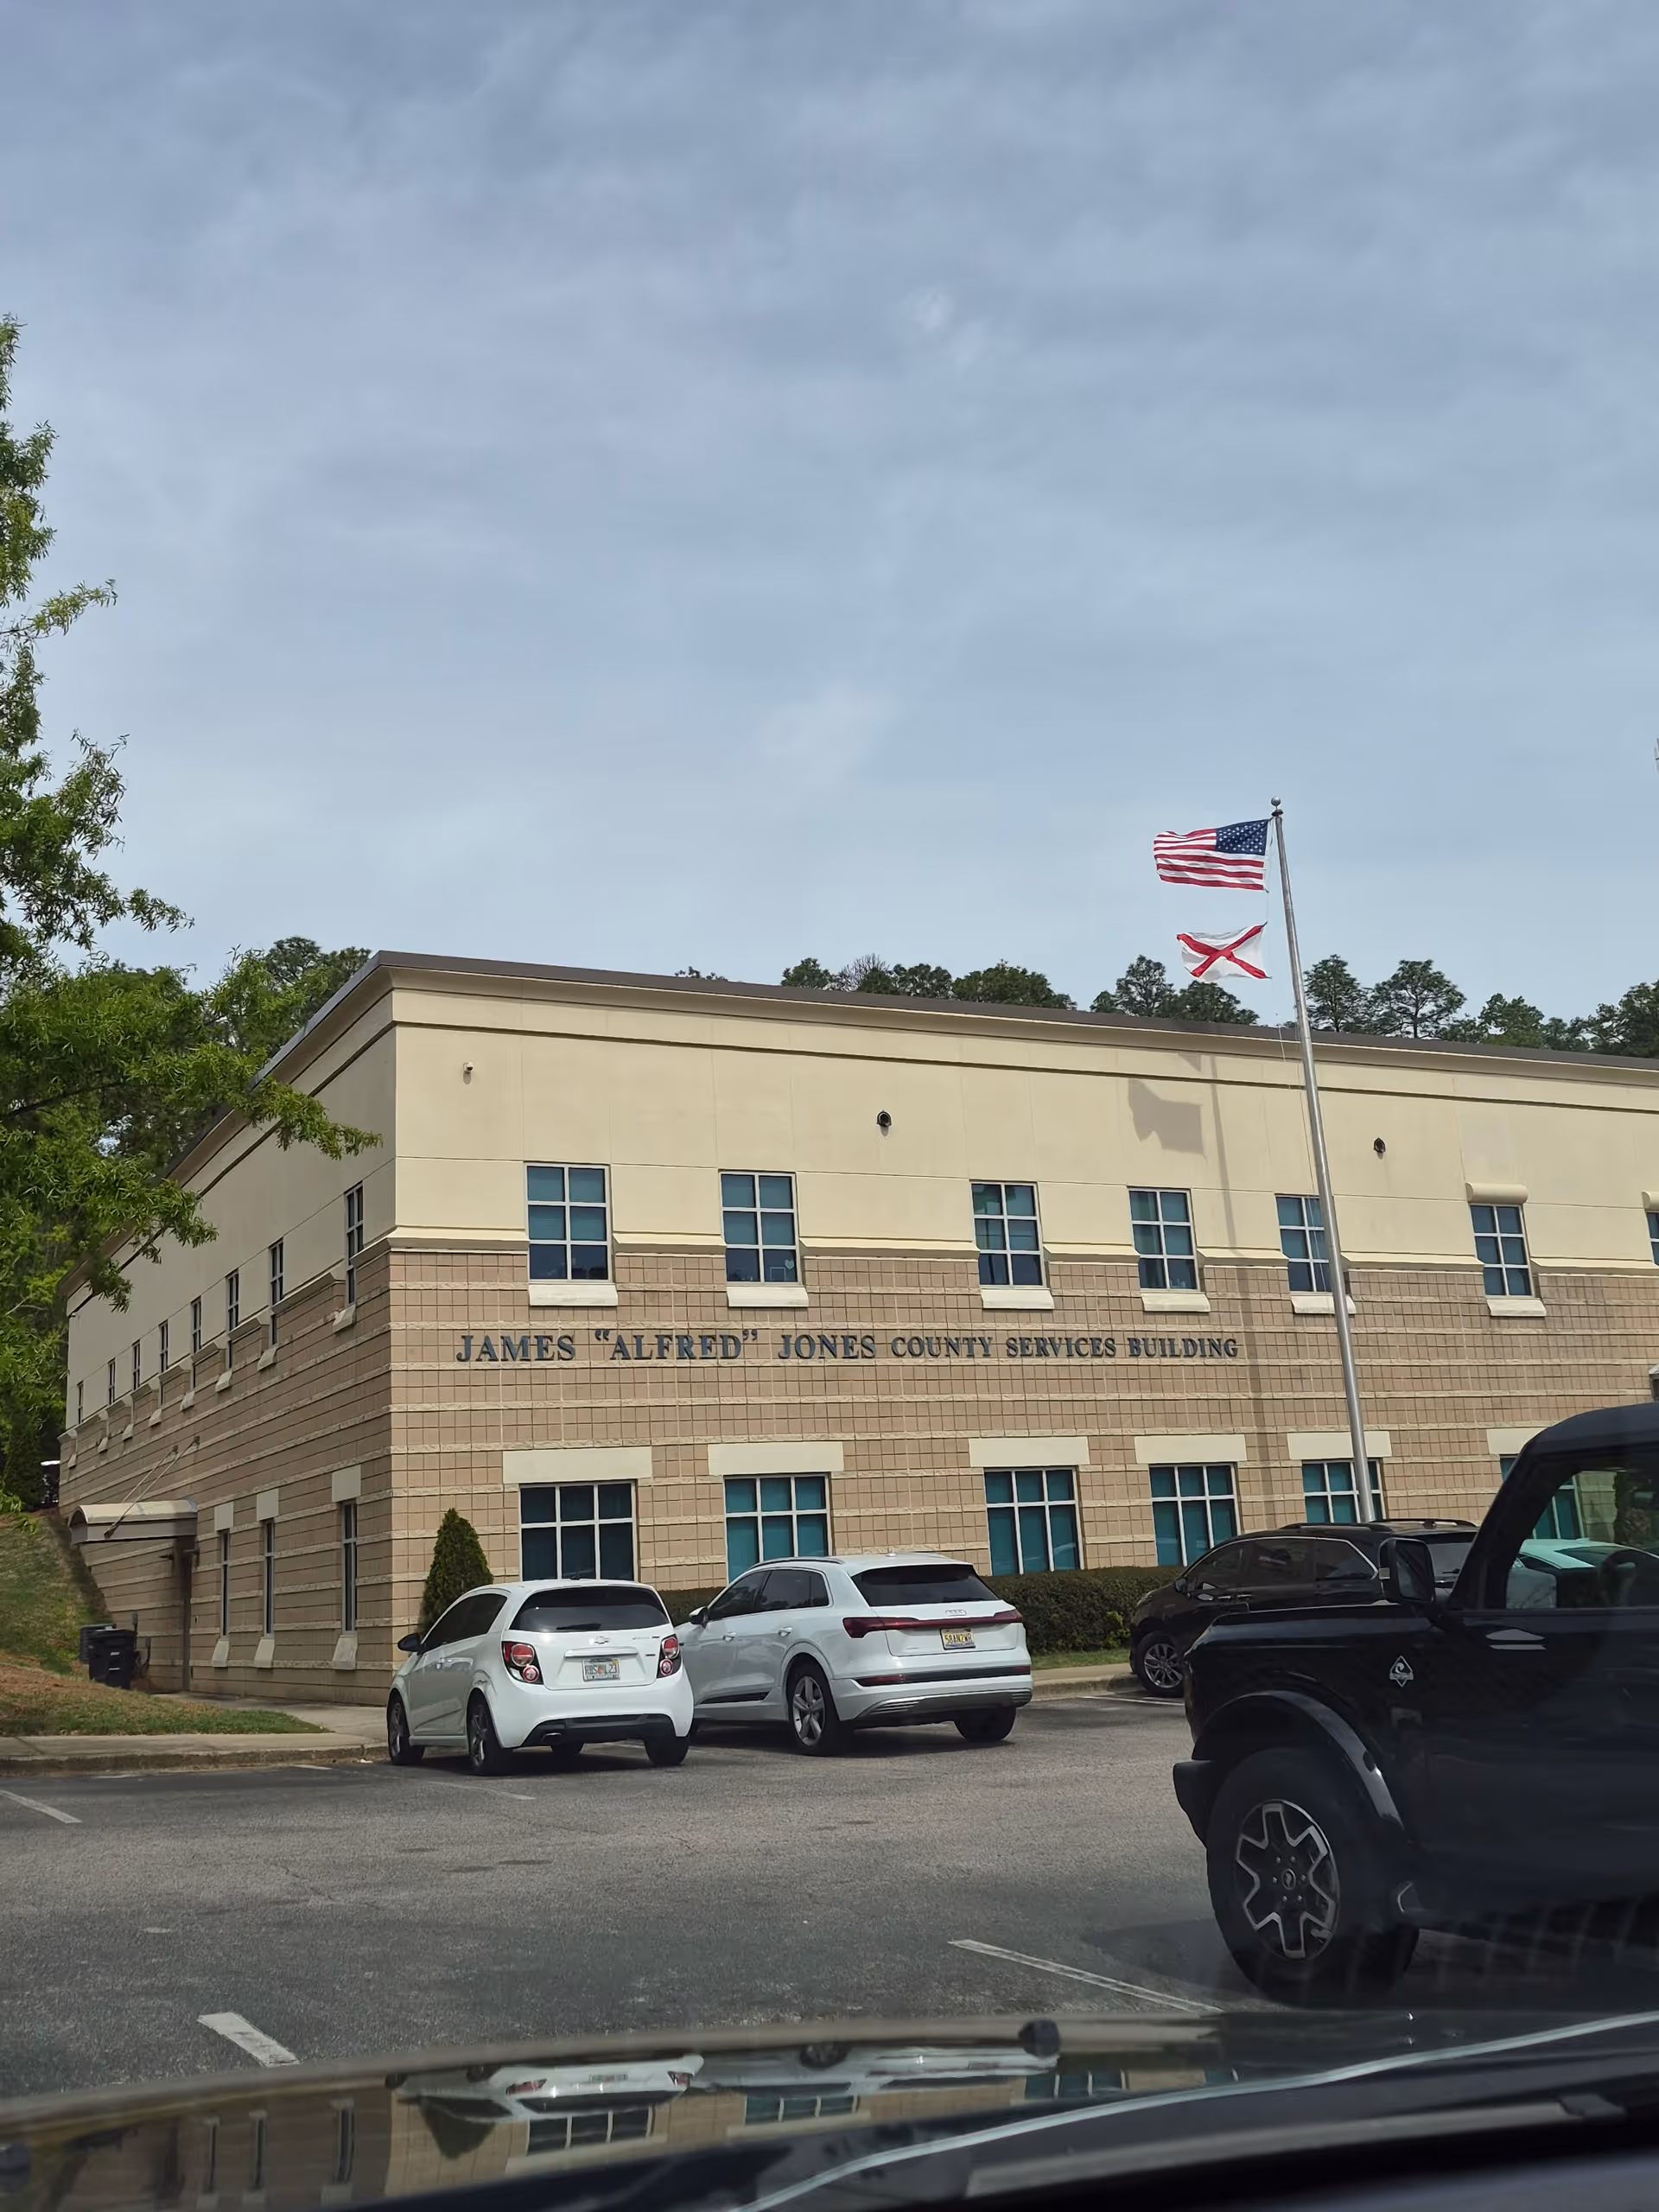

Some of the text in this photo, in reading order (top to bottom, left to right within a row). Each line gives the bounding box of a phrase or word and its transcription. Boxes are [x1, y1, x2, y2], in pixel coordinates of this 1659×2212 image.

[455, 1334, 575, 1362] JAMES
[777, 1334, 876, 1360] JONES
[891, 1336, 993, 1357] COUNTY
[1005, 1336, 1117, 1357] SERVICES
[1127, 1337, 1239, 1358] BUILDING
